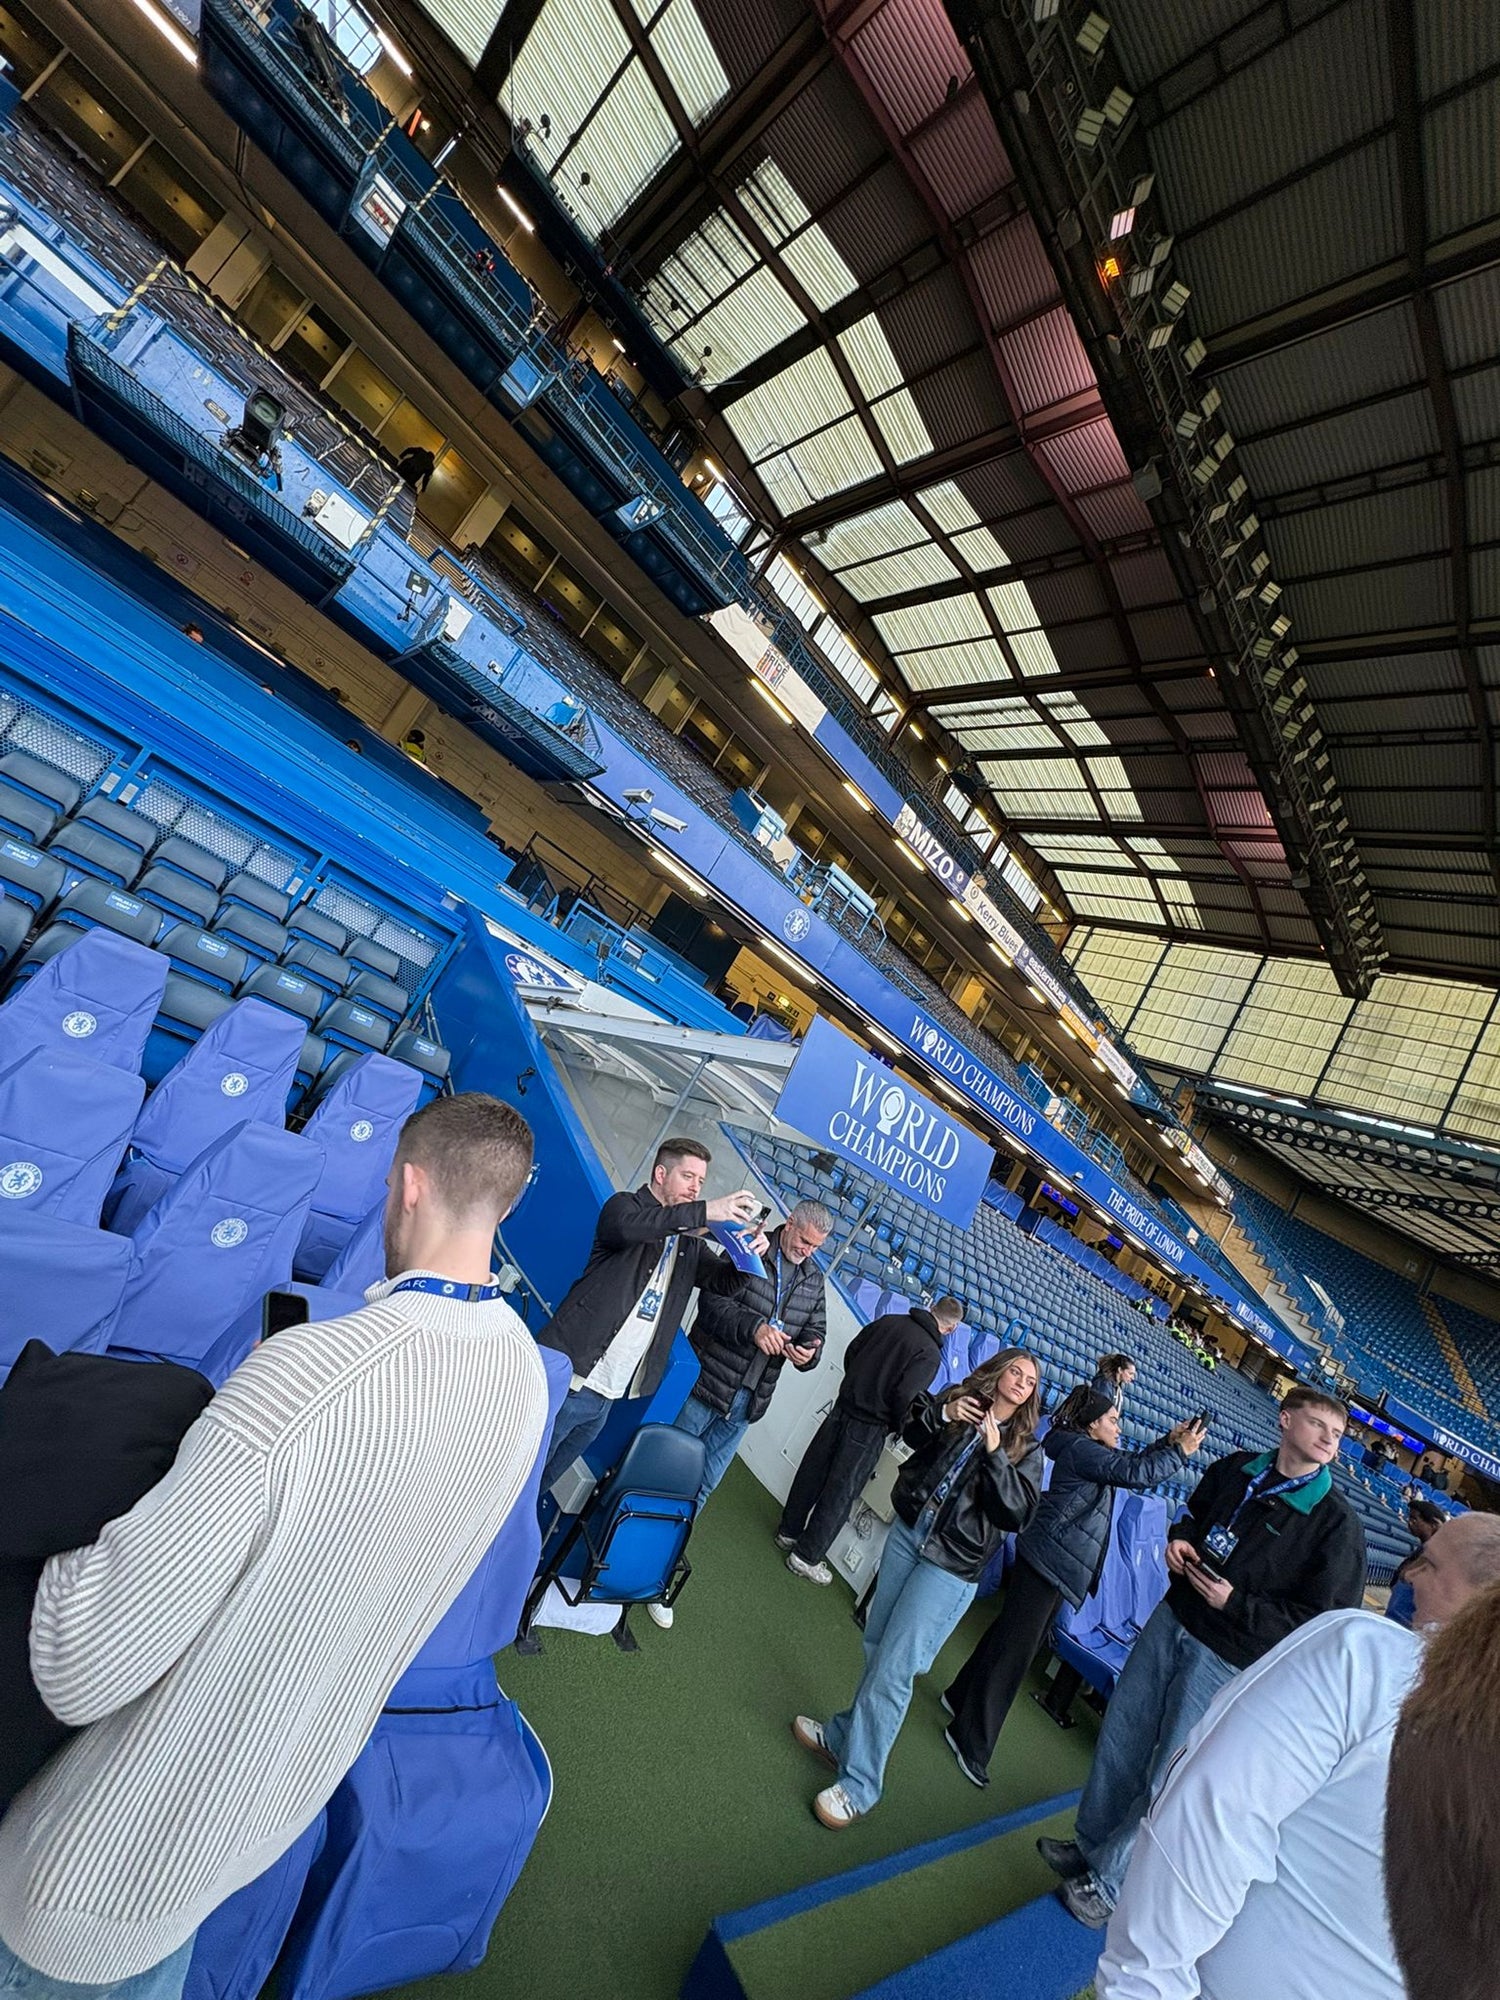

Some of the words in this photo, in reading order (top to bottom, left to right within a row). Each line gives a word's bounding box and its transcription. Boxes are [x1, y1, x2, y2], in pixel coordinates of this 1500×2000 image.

[908, 817, 954, 880] MIZO
[977, 900, 1000, 931] Kerry
[997, 925, 1019, 953] Blues
[909, 1014, 965, 1076] WORLD
[962, 1064, 1037, 1136] CHAMPIONS
[848, 1058, 960, 1171] WORLD
[828, 1109, 948, 1204] CHAMPIONS
[1106, 1187, 1127, 1214] THE
[1122, 1203, 1149, 1233] PRIDE
[1144, 1222, 1159, 1239] OF
[1154, 1230, 1186, 1263] LONDON
[412, 1279, 427, 1289] FC
[1432, 1428, 1470, 1458] WORLD
